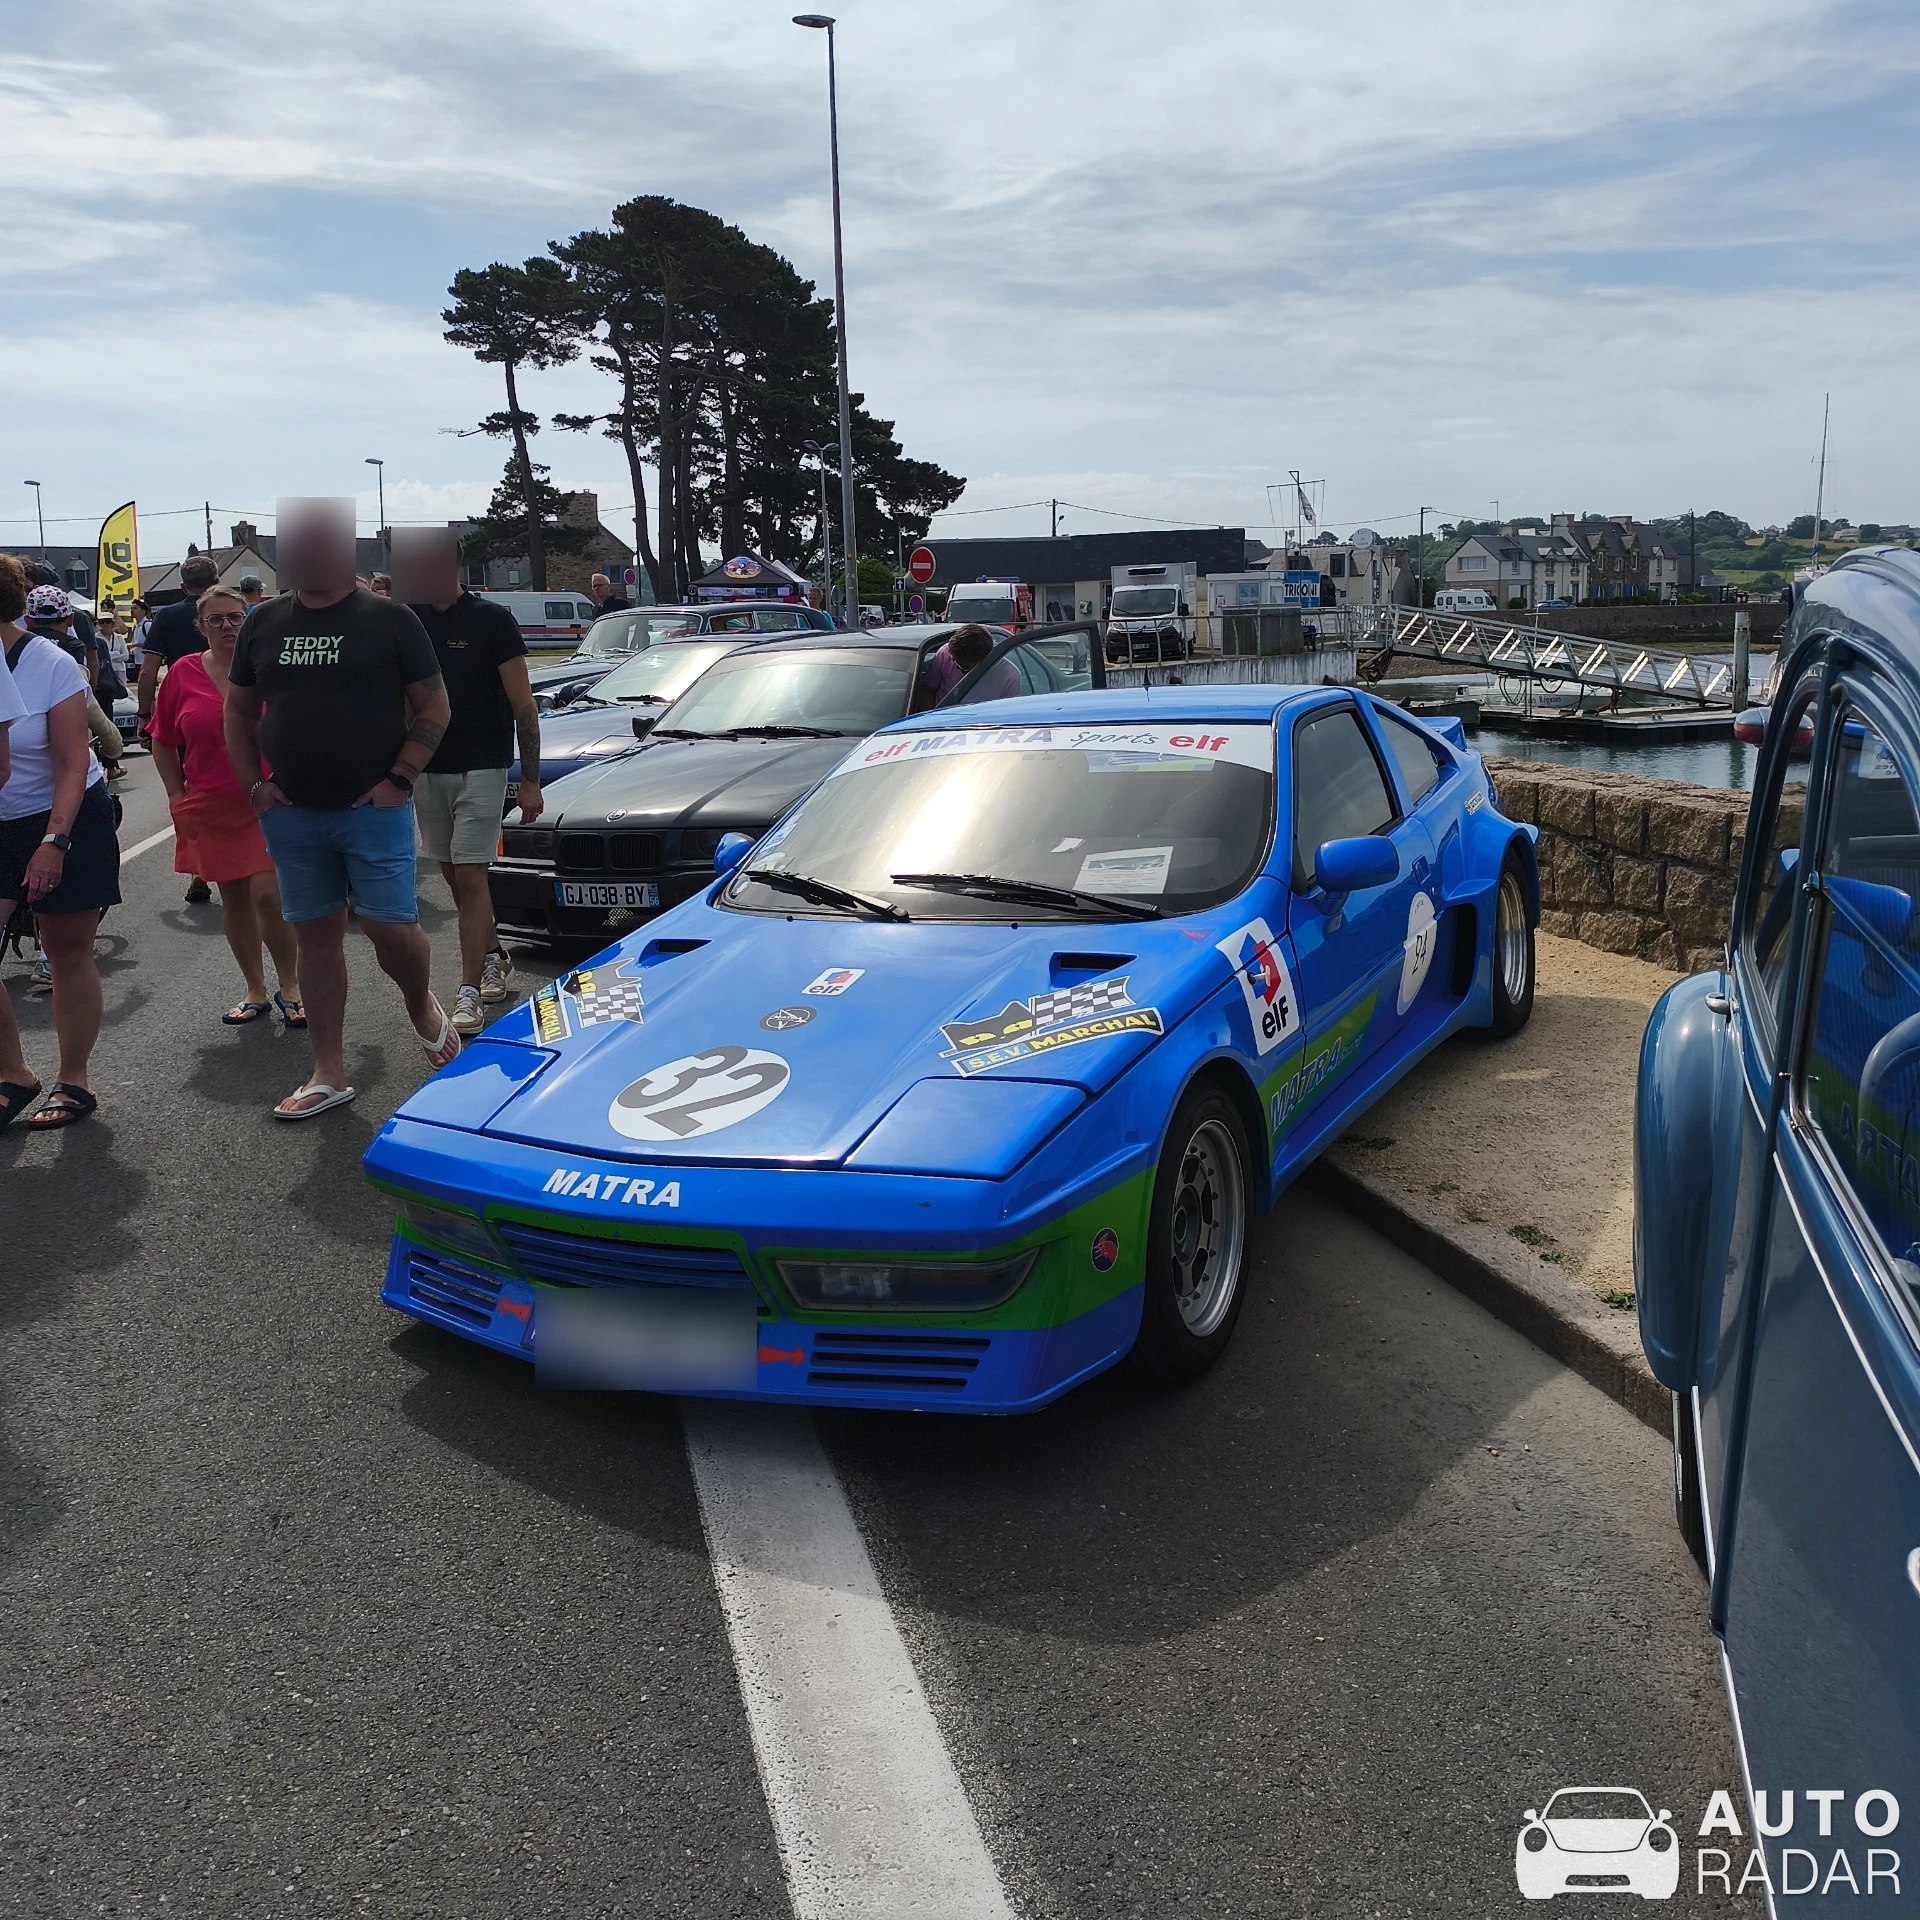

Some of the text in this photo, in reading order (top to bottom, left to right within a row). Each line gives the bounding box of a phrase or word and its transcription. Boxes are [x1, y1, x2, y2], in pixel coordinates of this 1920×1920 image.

[278, 650, 340, 665] SMITH
[283, 636, 344, 650] TEDDY
[864, 728, 1229, 762] elf MATRA Sports elf
[565, 885, 644, 905] GJ-038-BY
[650, 897, 659, 905] 56
[809, 985, 843, 994] elf
[538, 997, 561, 1041] MARCHAL
[1262, 995, 1288, 1039] elf
[968, 1013, 1157, 1069] S.E.V. MARCHAL
[617, 1045, 788, 1137] 32
[1271, 1037, 1341, 1136] MATRA
[542, 1168, 681, 1208] MATRA
